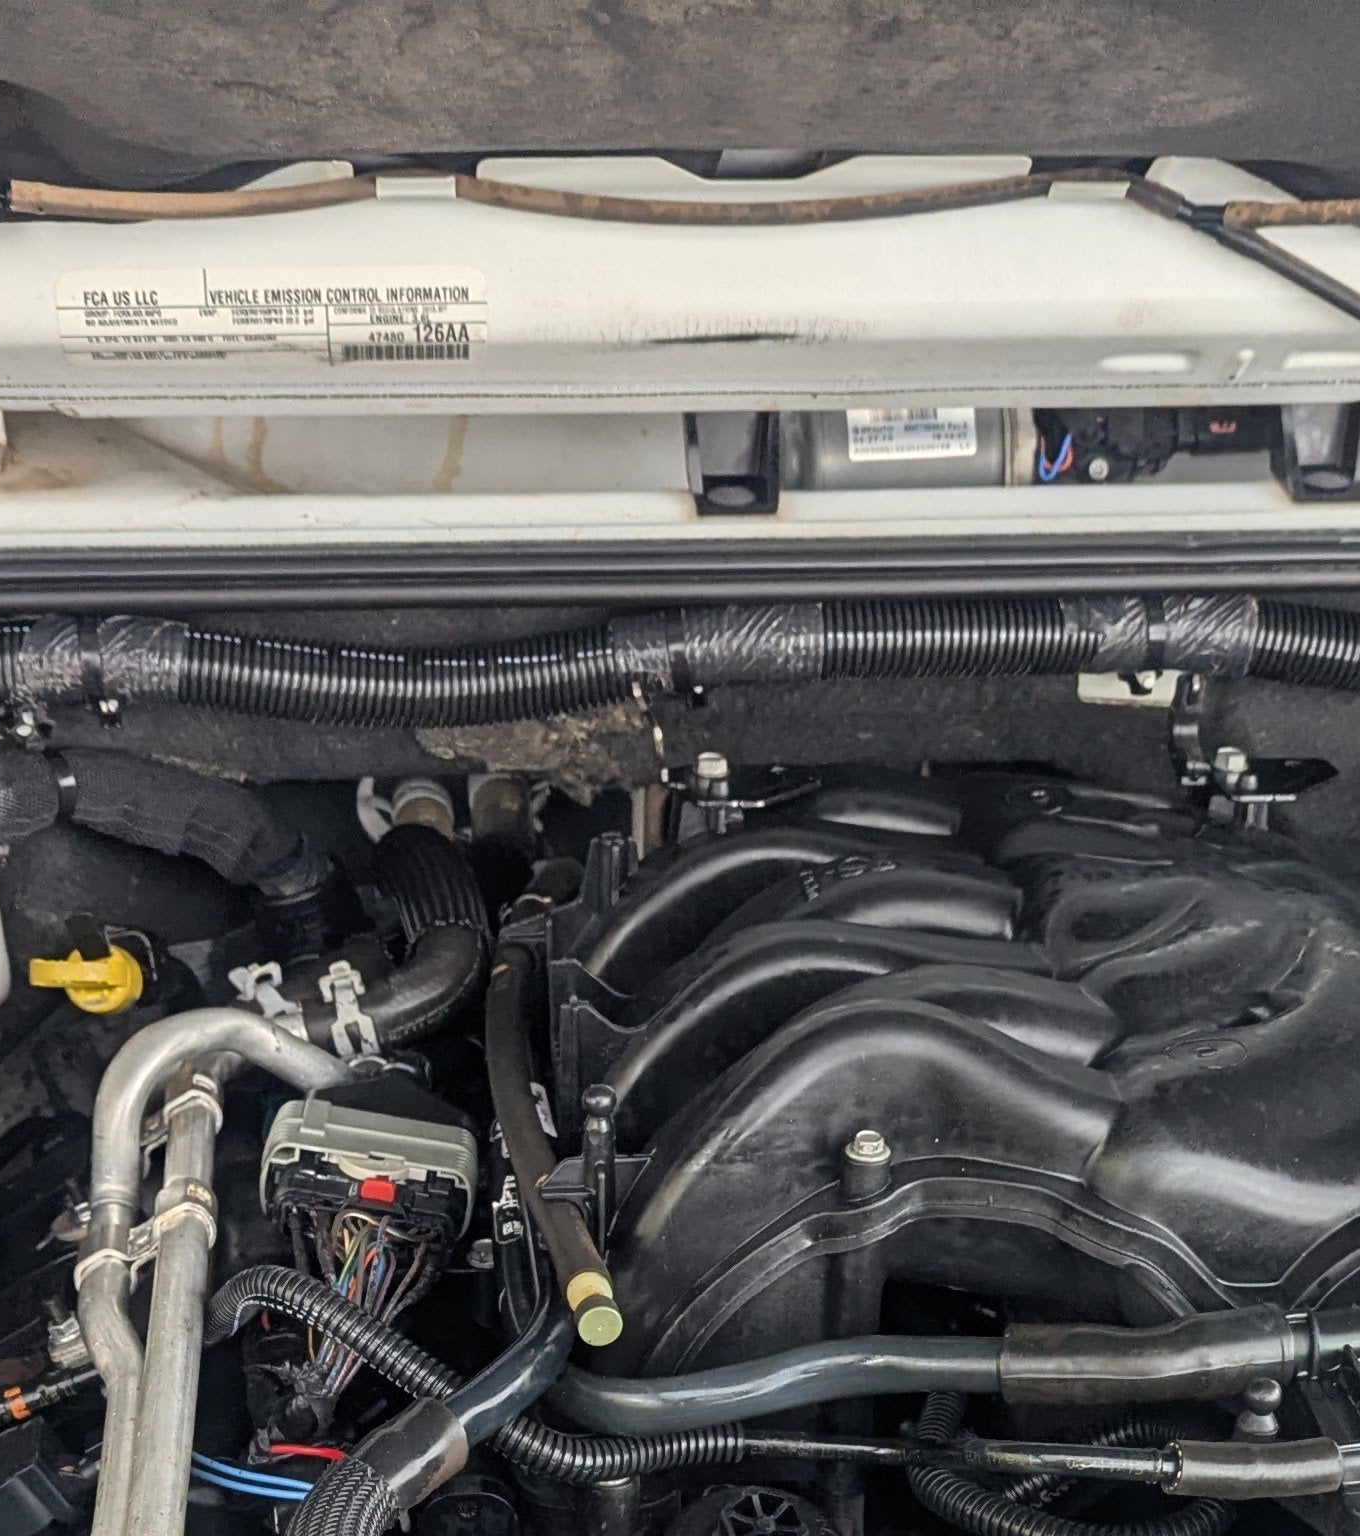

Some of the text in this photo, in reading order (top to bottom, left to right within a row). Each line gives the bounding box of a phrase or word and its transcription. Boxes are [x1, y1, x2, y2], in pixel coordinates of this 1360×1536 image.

[83, 290, 158, 306] FCA US LLC
[209, 286, 469, 305] VEHICLE EMISSION CONTROL INFORMATION
[413, 323, 470, 343] 126AA
